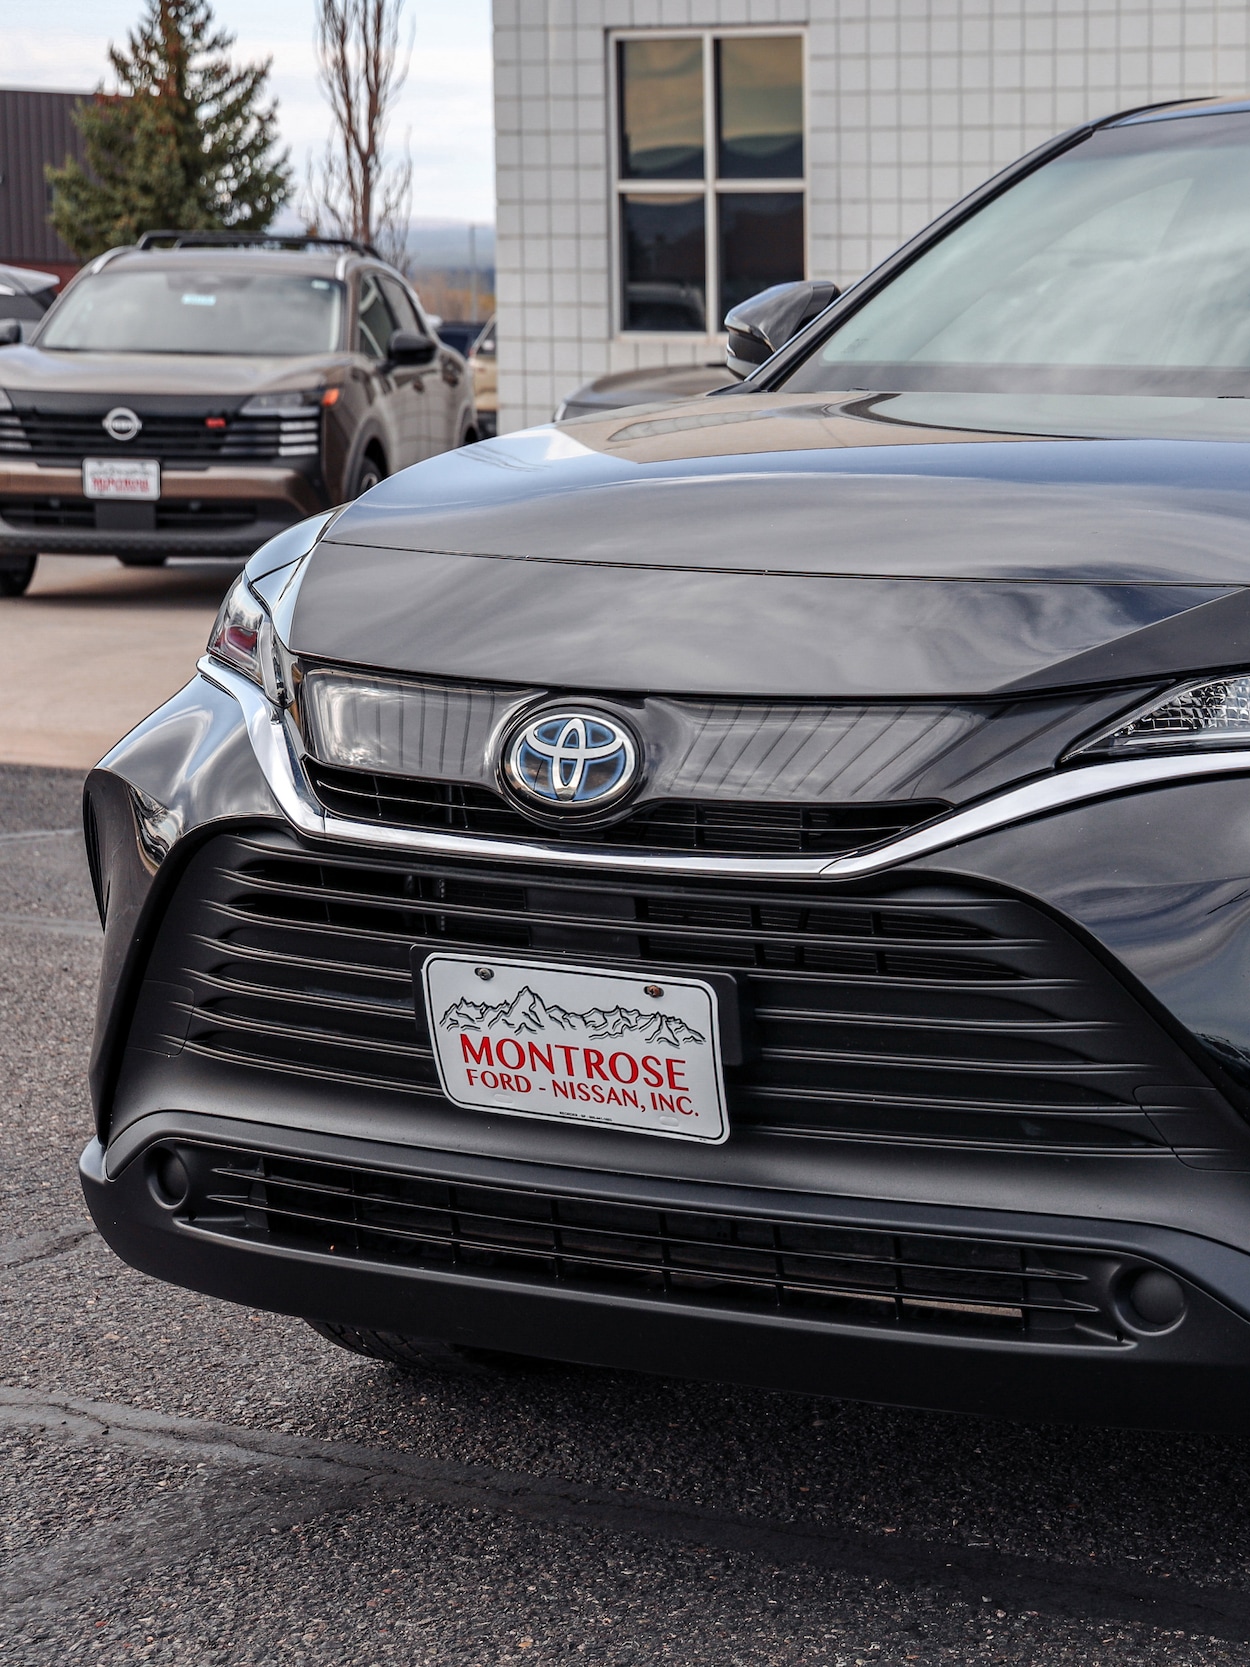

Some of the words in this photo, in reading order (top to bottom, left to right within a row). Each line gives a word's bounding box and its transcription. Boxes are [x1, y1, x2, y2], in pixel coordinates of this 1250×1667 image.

[460, 1033, 690, 1092] MONTROSE
[466, 1068, 532, 1093] FORD
[551, 1079, 646, 1113] NISSAN,
[650, 1092, 700, 1118] INC.
